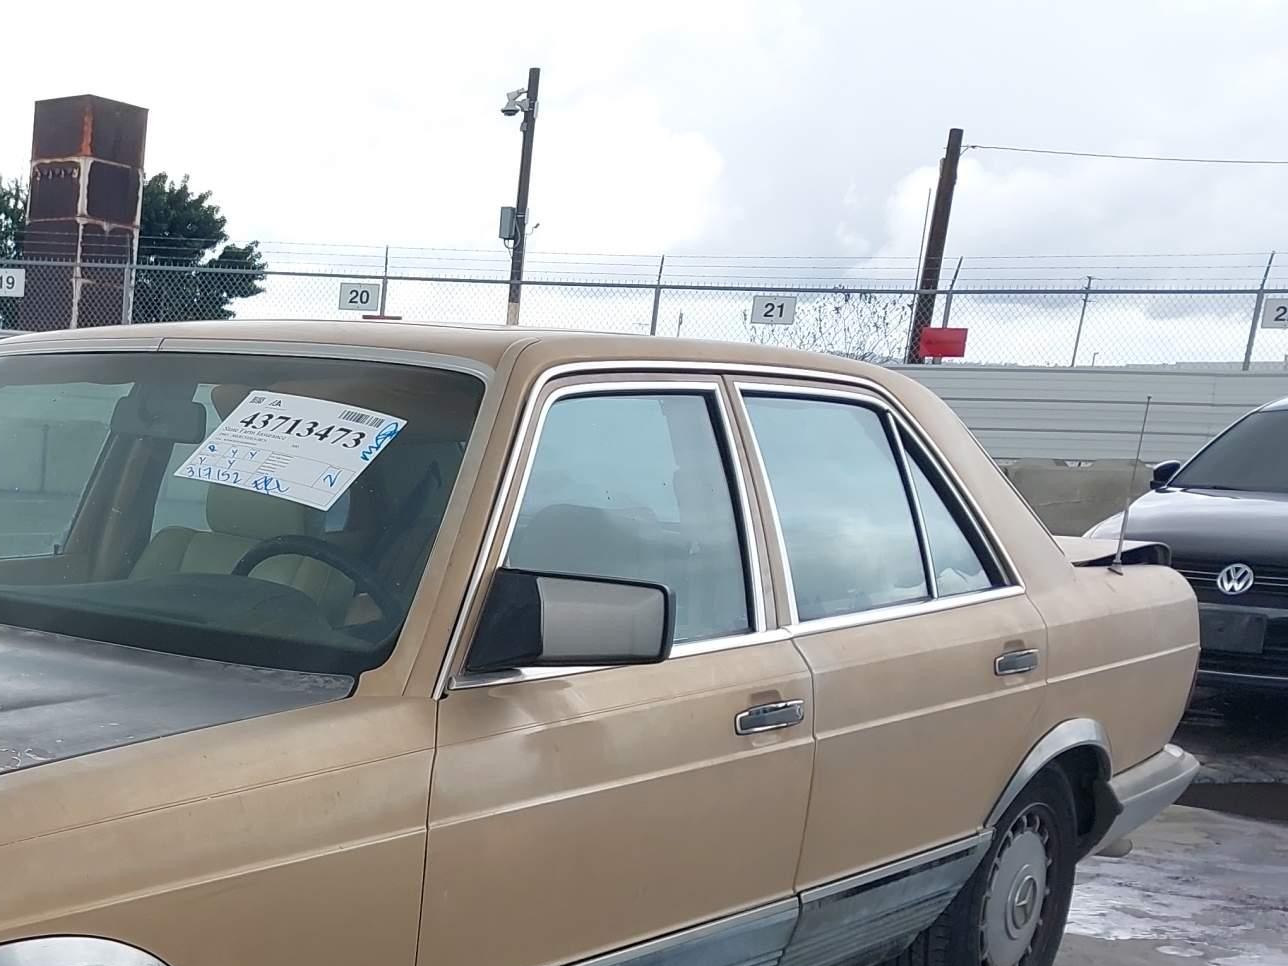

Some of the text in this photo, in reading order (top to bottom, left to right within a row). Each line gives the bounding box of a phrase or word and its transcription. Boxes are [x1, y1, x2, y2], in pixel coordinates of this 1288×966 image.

[348, 289, 370, 305] 20
[763, 302, 785, 318] 21
[1273, 305, 1288, 322] 2
[240, 411, 367, 449] 43713473
